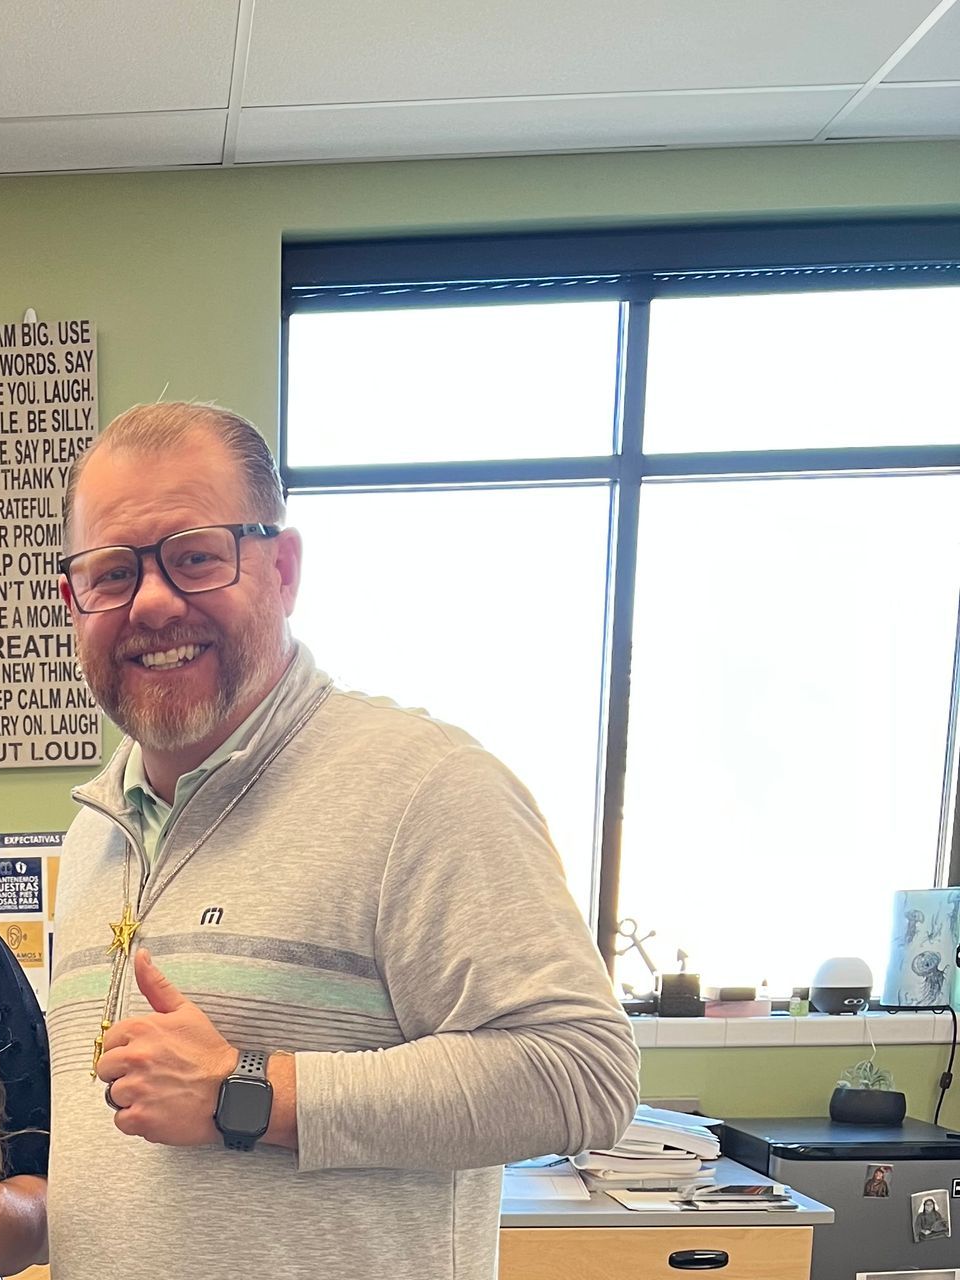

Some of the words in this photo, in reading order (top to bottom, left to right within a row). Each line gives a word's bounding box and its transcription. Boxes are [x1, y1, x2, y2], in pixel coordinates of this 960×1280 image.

[22, 323, 53, 346] BIG.
[58, 320, 90, 344] USE
[0, 352, 60, 376] WORDS.
[65, 350, 93, 373] SAY
[8, 382, 39, 405] YOU.
[44, 379, 94, 403] LAUGH.
[28, 410, 47, 433] BE
[52, 408, 93, 432] SILLY.
[15, 440, 39, 464] SAY
[1, 467, 54, 490] THANK
[59, 466, 69, 488] Y
[14, 524, 61, 547] PROMI
[19, 552, 62, 576] OTHE
[30, 580, 60, 600] WH
[12, 606, 22, 628] A
[27, 605, 72, 627] MOME
[2, 663, 35, 683] NEW
[18, 688, 61, 709] CALM
[23, 715, 46, 735] ON.
[51, 714, 98, 735] LAUGH
[31, 741, 101, 760] LOUD.
[4, 835, 60, 844] EXPECTATIVAS
